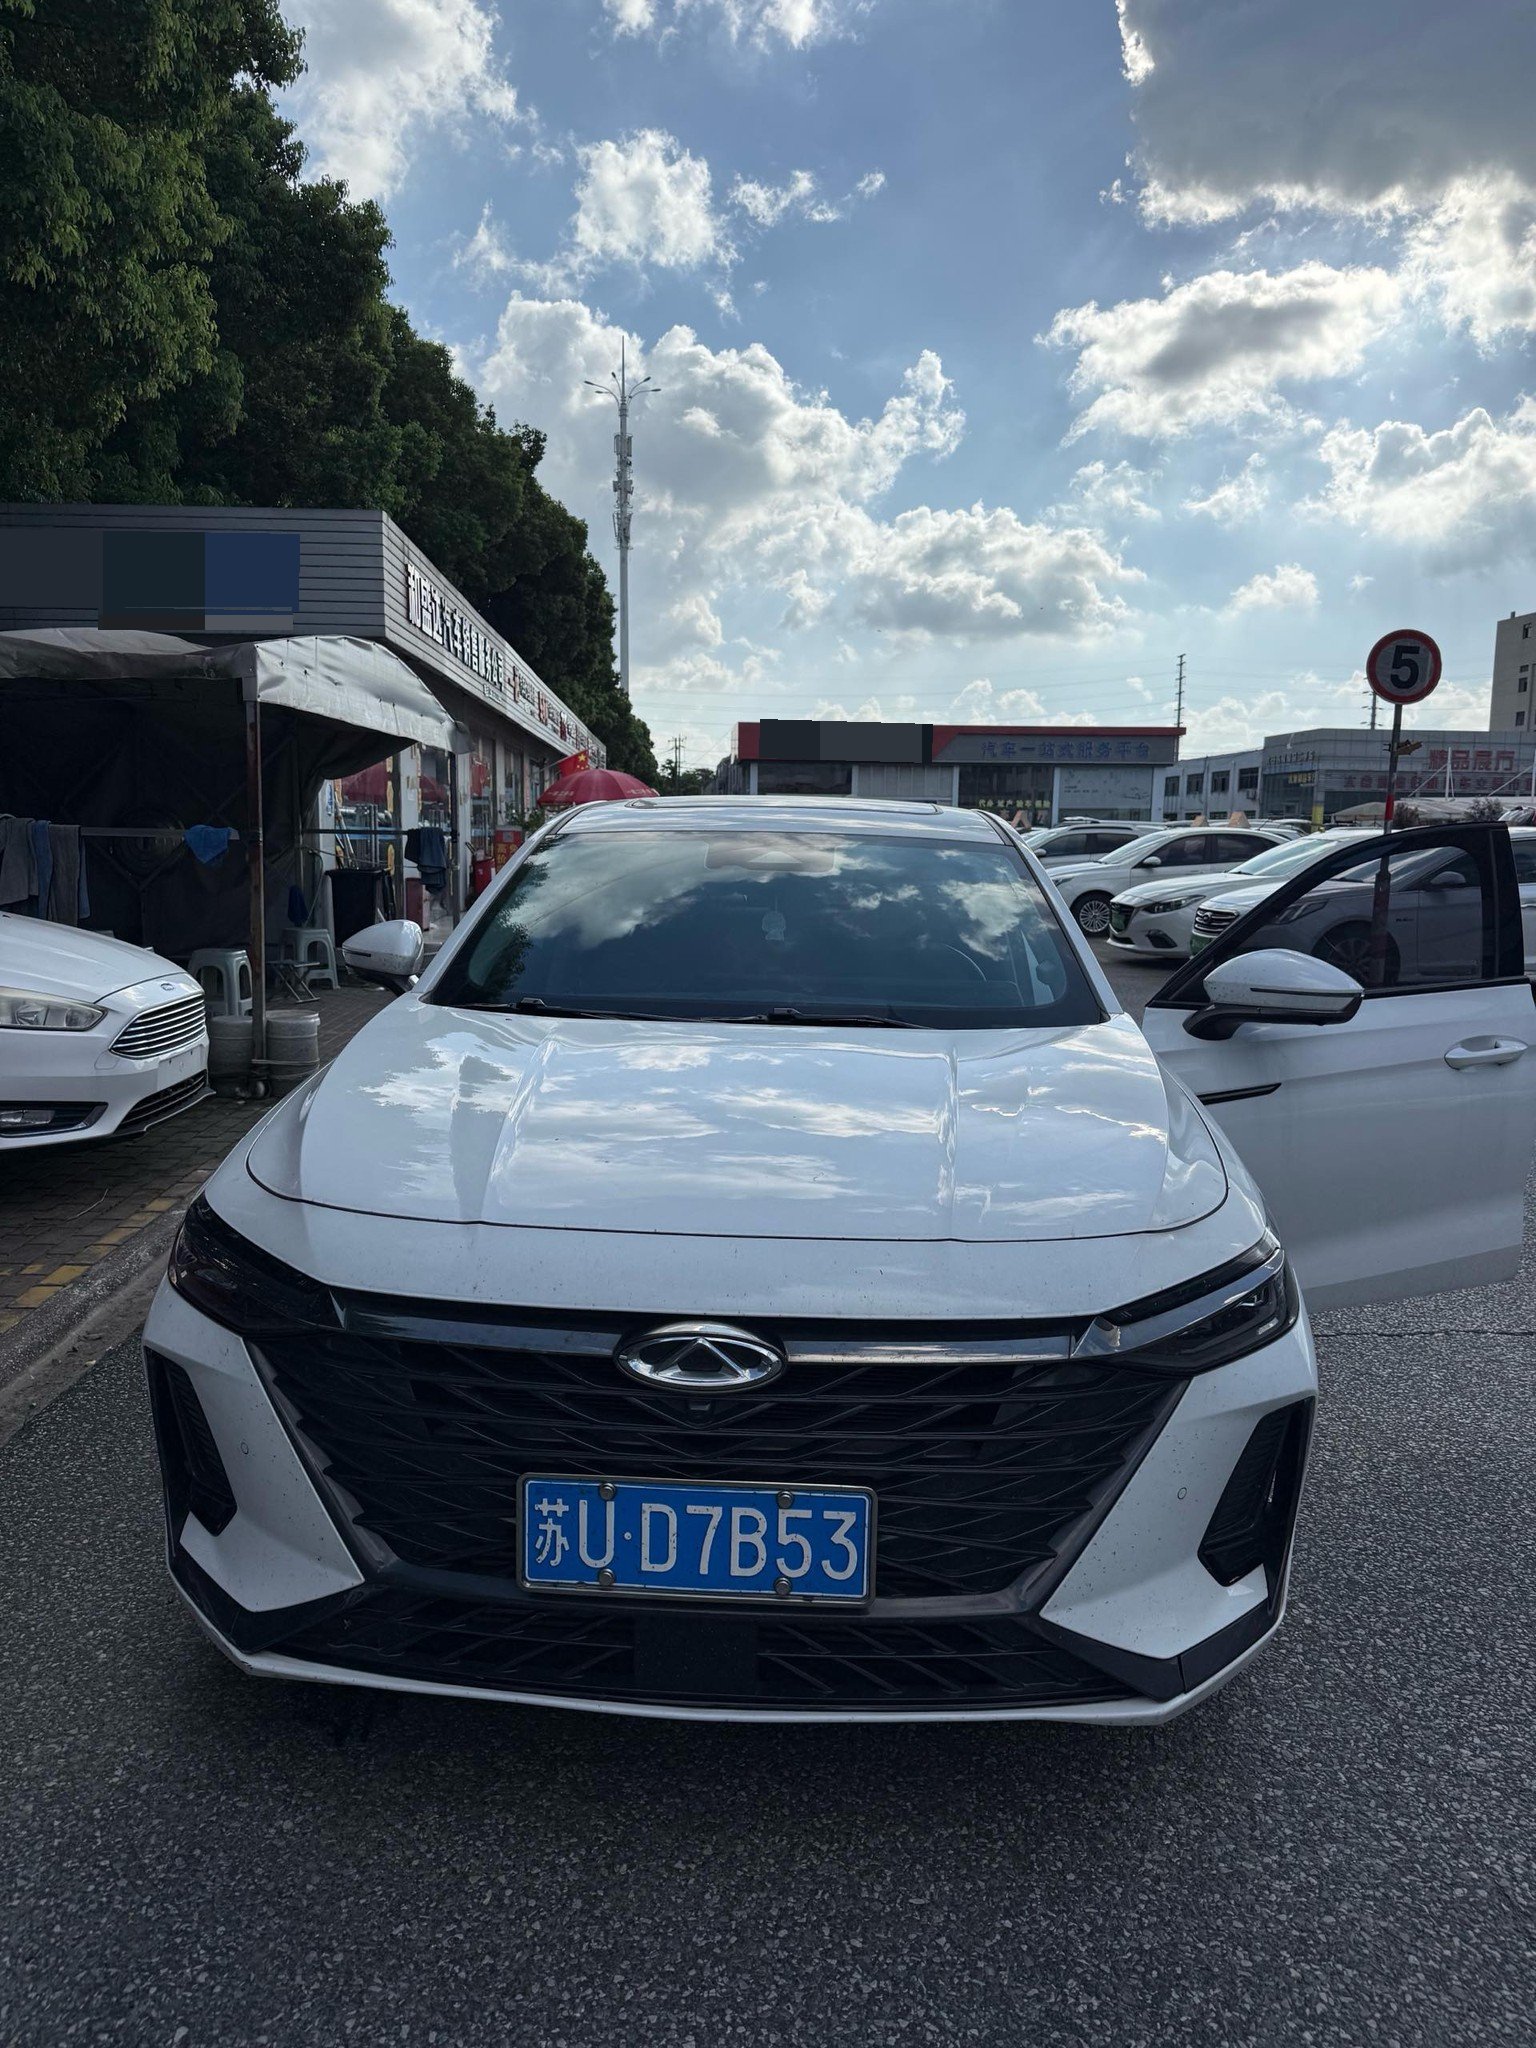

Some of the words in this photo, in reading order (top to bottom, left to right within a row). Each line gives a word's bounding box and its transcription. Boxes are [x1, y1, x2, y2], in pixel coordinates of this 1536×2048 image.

[1390, 645, 1420, 689] 5
[981, 741, 1150, 759] 汽车一站式服务平台
[534, 1497, 858, 1581] 苏U·D7B53
